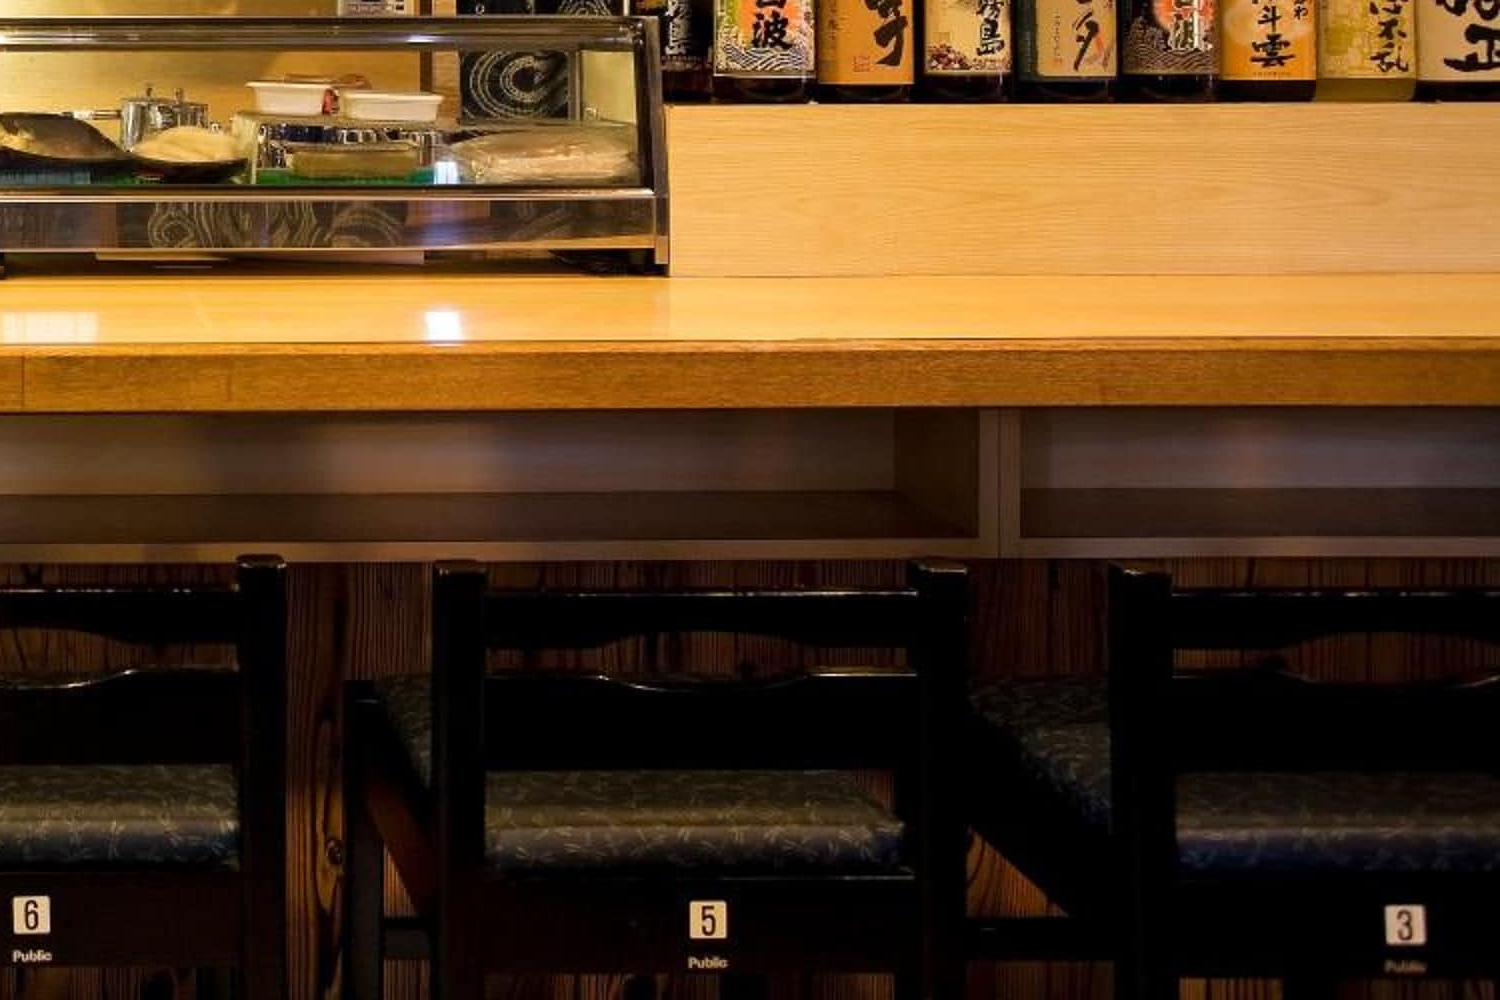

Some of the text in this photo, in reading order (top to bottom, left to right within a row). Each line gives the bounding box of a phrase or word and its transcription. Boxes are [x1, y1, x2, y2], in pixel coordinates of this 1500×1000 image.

[25, 900, 38, 930] 6
[701, 905, 716, 936] 5
[1396, 910, 1412, 941] 3
[13, 949, 53, 963] Public
[687, 956, 729, 969] Public
